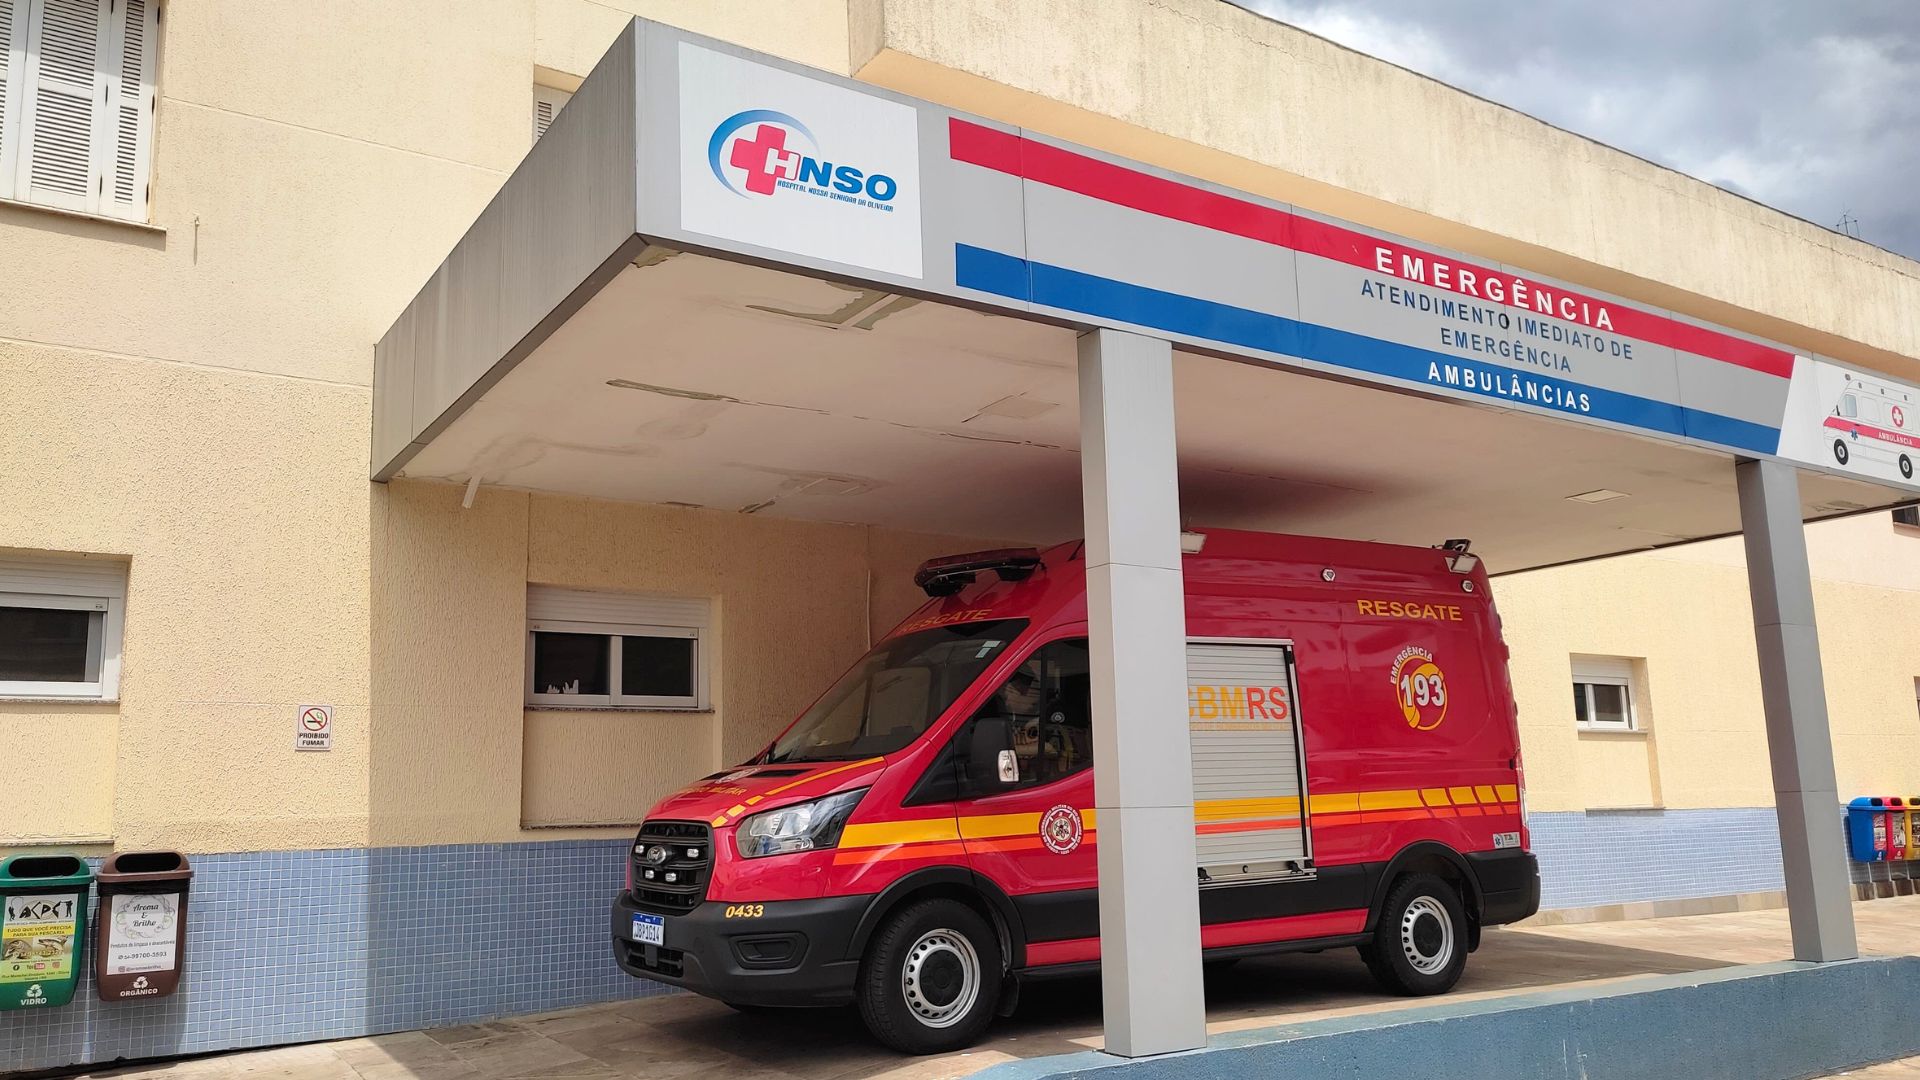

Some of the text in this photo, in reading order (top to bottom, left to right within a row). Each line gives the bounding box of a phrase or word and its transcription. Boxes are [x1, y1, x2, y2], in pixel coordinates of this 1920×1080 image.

[763, 147, 897, 201] HNSO
[777, 180, 806, 193] HOSPITAL
[808, 187, 828, 198] NOSSA
[1375, 246, 1615, 331] EMERGÊNCIA
[1361, 279, 1633, 360] ATENDIMENTO IMEDIATO DE
[1440, 327, 1572, 373] EMERGÊNCIA
[1428, 361, 1591, 412] AMBULÂNCIAS
[1356, 599, 1463, 621] RESGATE
[1390, 645, 1433, 685] EMERGÊNCIA
[1400, 674, 1445, 707] 193
[133, 903, 159, 912] Aroma
[725, 904, 765, 919] 0433
[20, 997, 48, 1006] VIDRO
[120, 988, 158, 997] ORGÂNICO
